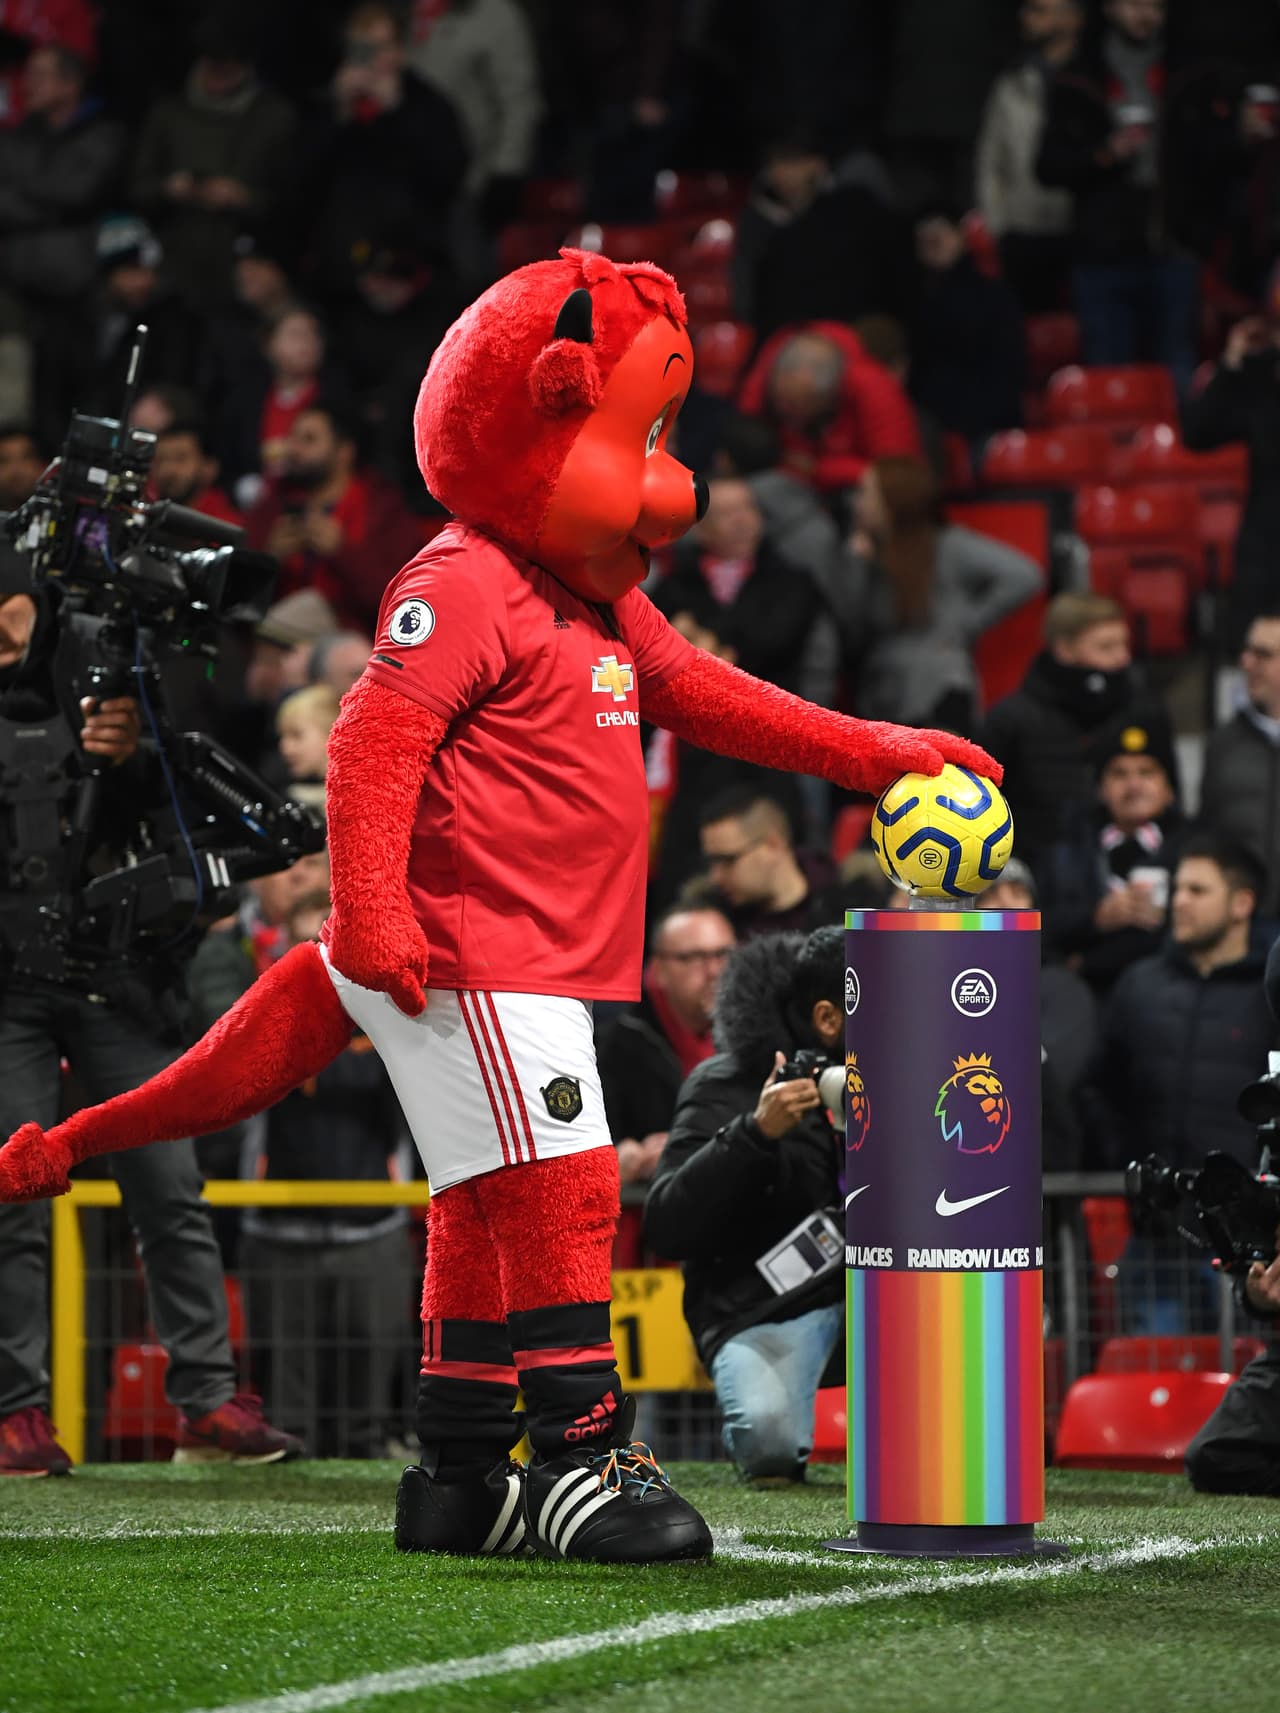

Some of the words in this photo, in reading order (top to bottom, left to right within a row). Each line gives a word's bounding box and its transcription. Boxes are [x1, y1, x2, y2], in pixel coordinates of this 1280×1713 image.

[959, 978, 990, 996] EA
[959, 995, 990, 1004] SPORTS
[857, 1246, 893, 1267] LACES
[907, 1247, 991, 1268] RAINBOW
[993, 1247, 1030, 1268] LACES
